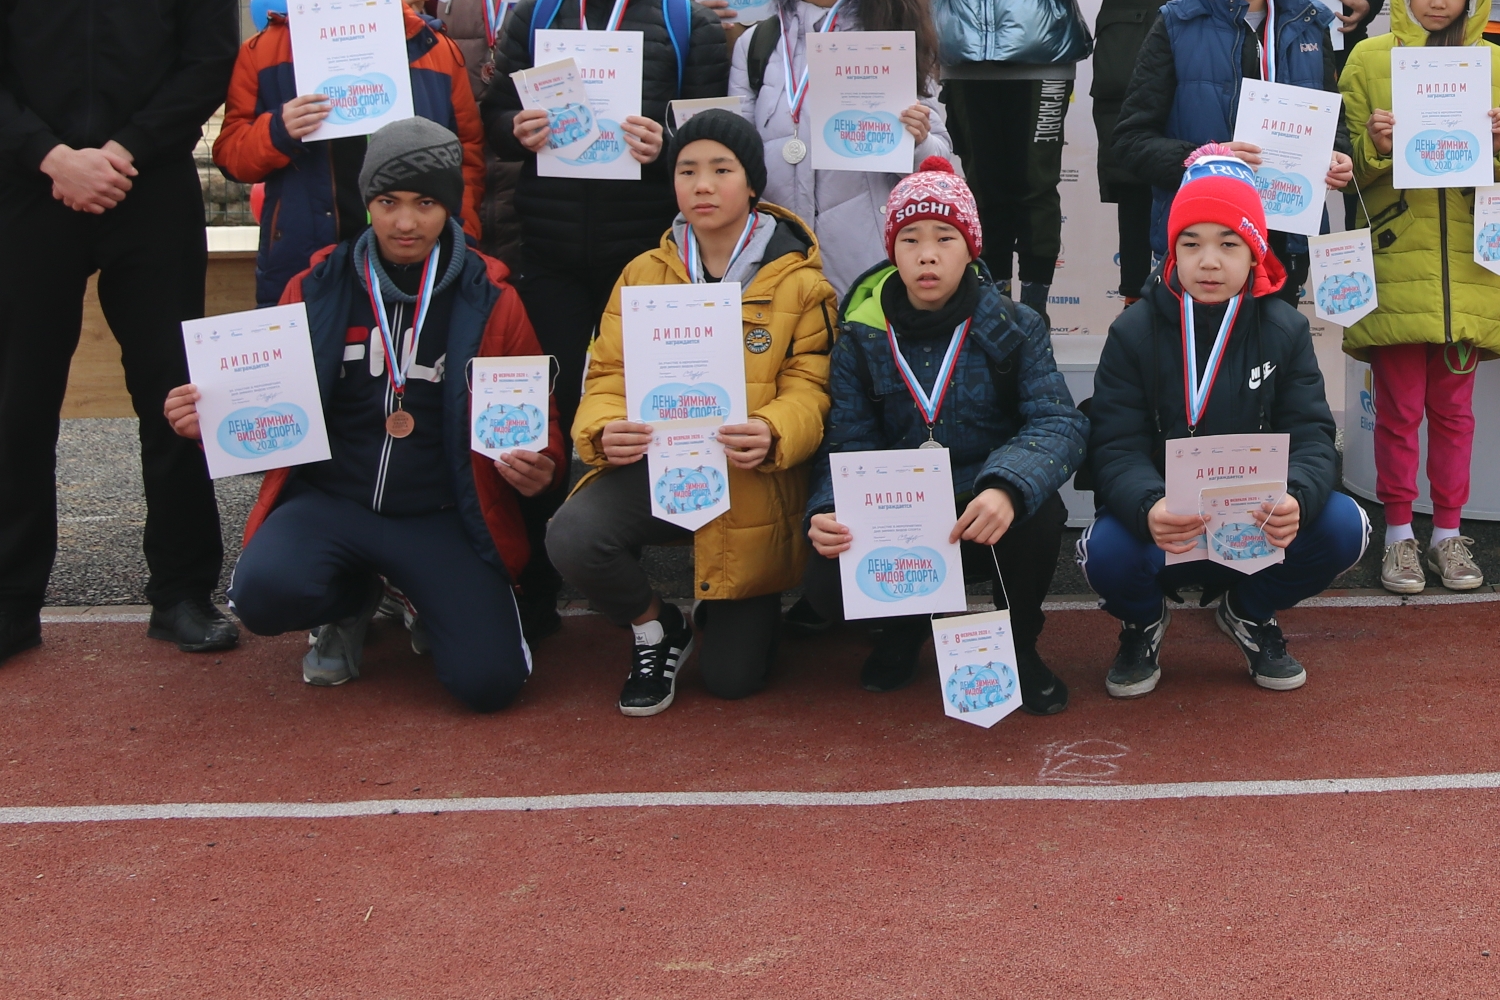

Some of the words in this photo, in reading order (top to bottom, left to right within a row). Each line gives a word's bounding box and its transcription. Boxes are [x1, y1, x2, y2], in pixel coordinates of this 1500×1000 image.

[320, 22, 377, 39] ДИПЛОМ
[835, 65, 890, 76] ДИПЛОМ
[1416, 83, 1467, 95] ДИПЛОМ
[347, 106, 367, 117] 2020
[1033, 79, 1066, 143] MPARABLE
[834, 119, 856, 132] ДЕНЬ
[858, 120, 891, 132] ЗИМНИХ
[1261, 118, 1313, 136] ДИПЛОМ
[840, 131, 866, 142] ВИДОВ
[866, 131, 895, 144] СПОРТА
[854, 142, 873, 152] 2020
[1415, 139, 1436, 153] ДЕНЬ
[1437, 139, 1469, 150] ЗИМНИХ
[1420, 149, 1445, 161] ВИДОВ
[1446, 149, 1473, 161] СПОРТА
[366, 141, 462, 196] MERRE
[1434, 160, 1452, 170] 2020
[1209, 164, 1255, 187] RUS
[1270, 179, 1303, 195] ЗИМНИХ
[1277, 192, 1304, 207] СПОРТА
[1488, 197, 1492, 205] 8
[895, 201, 951, 223] SOCHI
[1264, 201, 1282, 212] 2020
[1325, 248, 1330, 257] 8
[1048, 295, 1080, 305] ГАЗПРОМ
[653, 326, 713, 341] ДИПЛОМ
[220, 348, 283, 370] ДИПЛОМ
[1251, 361, 1271, 381] NIKE
[492, 373, 498, 383] 8
[652, 395, 677, 410] ДЕНЬ
[679, 395, 717, 407] ЗИМНИХ
[659, 407, 689, 420] ВИДОВ
[689, 406, 722, 418] СПОРТА
[228, 419, 254, 435] ДЕНЬ
[254, 414, 294, 427] ЗИМНИХ
[1361, 416, 1375, 432] Elist
[237, 429, 267, 442] ВИДОВ
[268, 424, 302, 439] СПОРТА
[256, 439, 278, 451] 2020
[667, 436, 673, 446] 8
[1196, 465, 1258, 479] ДИПЛОМ
[865, 491, 925, 506] ДИПЛОМ
[1224, 498, 1230, 506] 8
[878, 503, 912, 511] награждается
[868, 558, 893, 574] ДЕНЬ
[894, 559, 932, 570] ЗИМНИХ
[875, 571, 905, 584] ВИДОВ
[906, 569, 939, 583] СПОРТА
[893, 582, 914, 594] 2020
[955, 633, 961, 644] 8
[976, 679, 1000, 687] ЗИМНИХ
[965, 687, 983, 696] ВИДОВ
